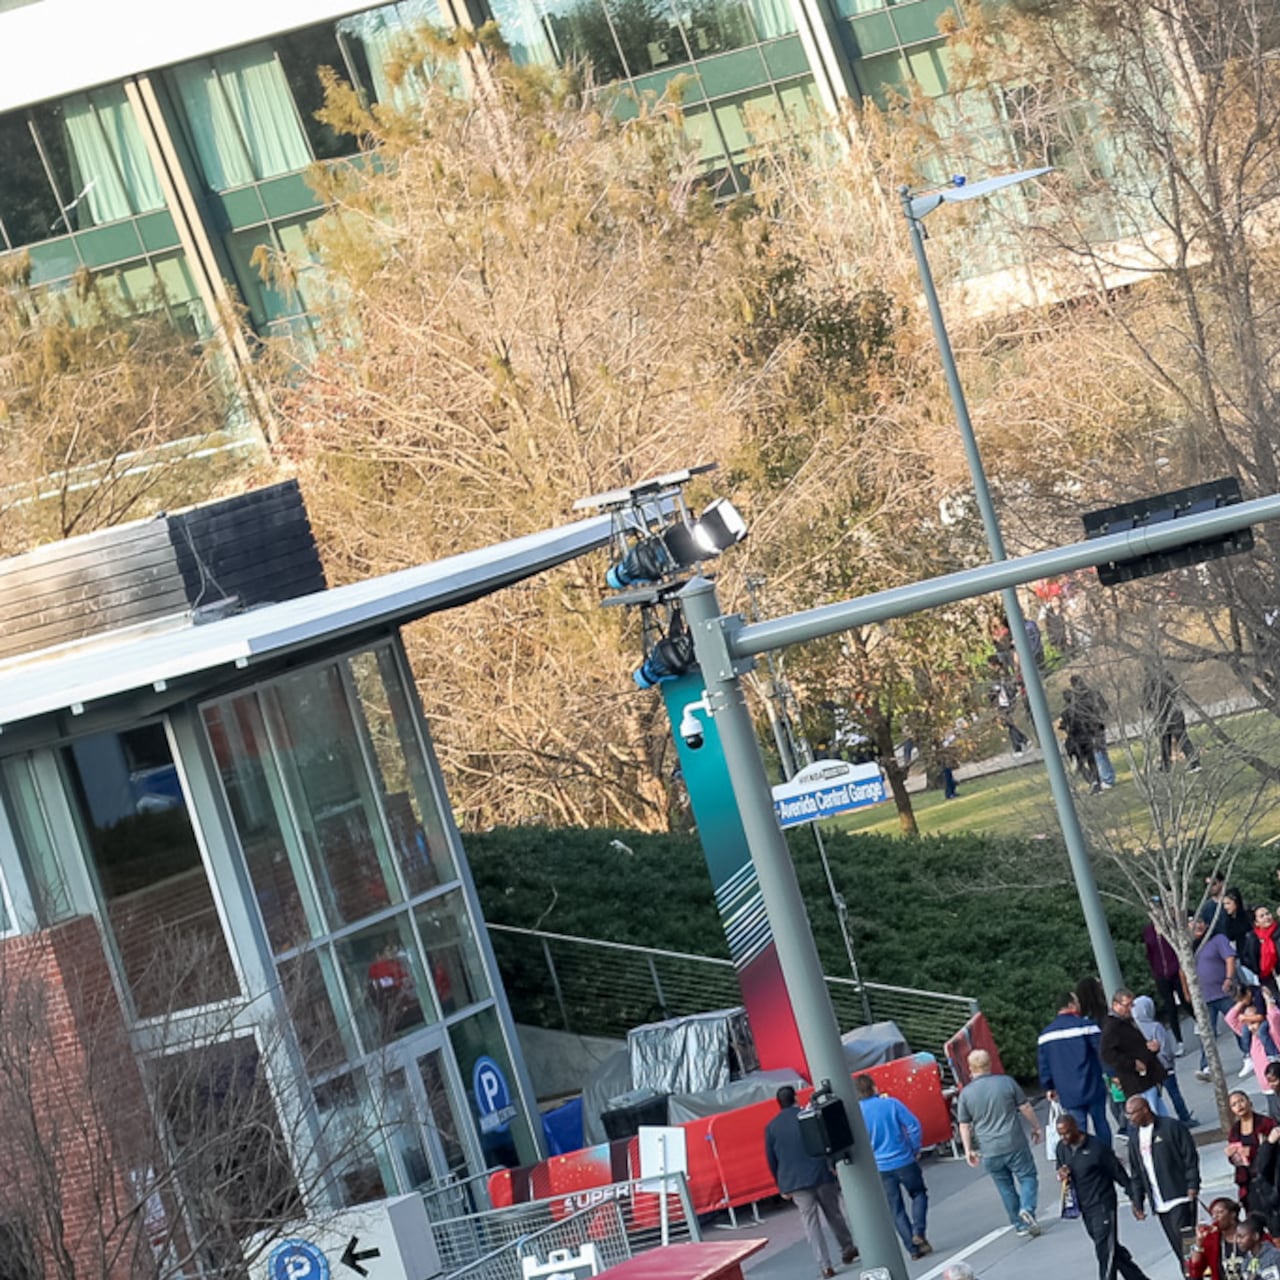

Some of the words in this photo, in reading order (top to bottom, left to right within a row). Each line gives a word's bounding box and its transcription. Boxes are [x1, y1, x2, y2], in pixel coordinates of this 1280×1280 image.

[780, 794, 816, 820] Avenida
[815, 788, 848, 810] Central
[848, 779, 884, 805] Garage
